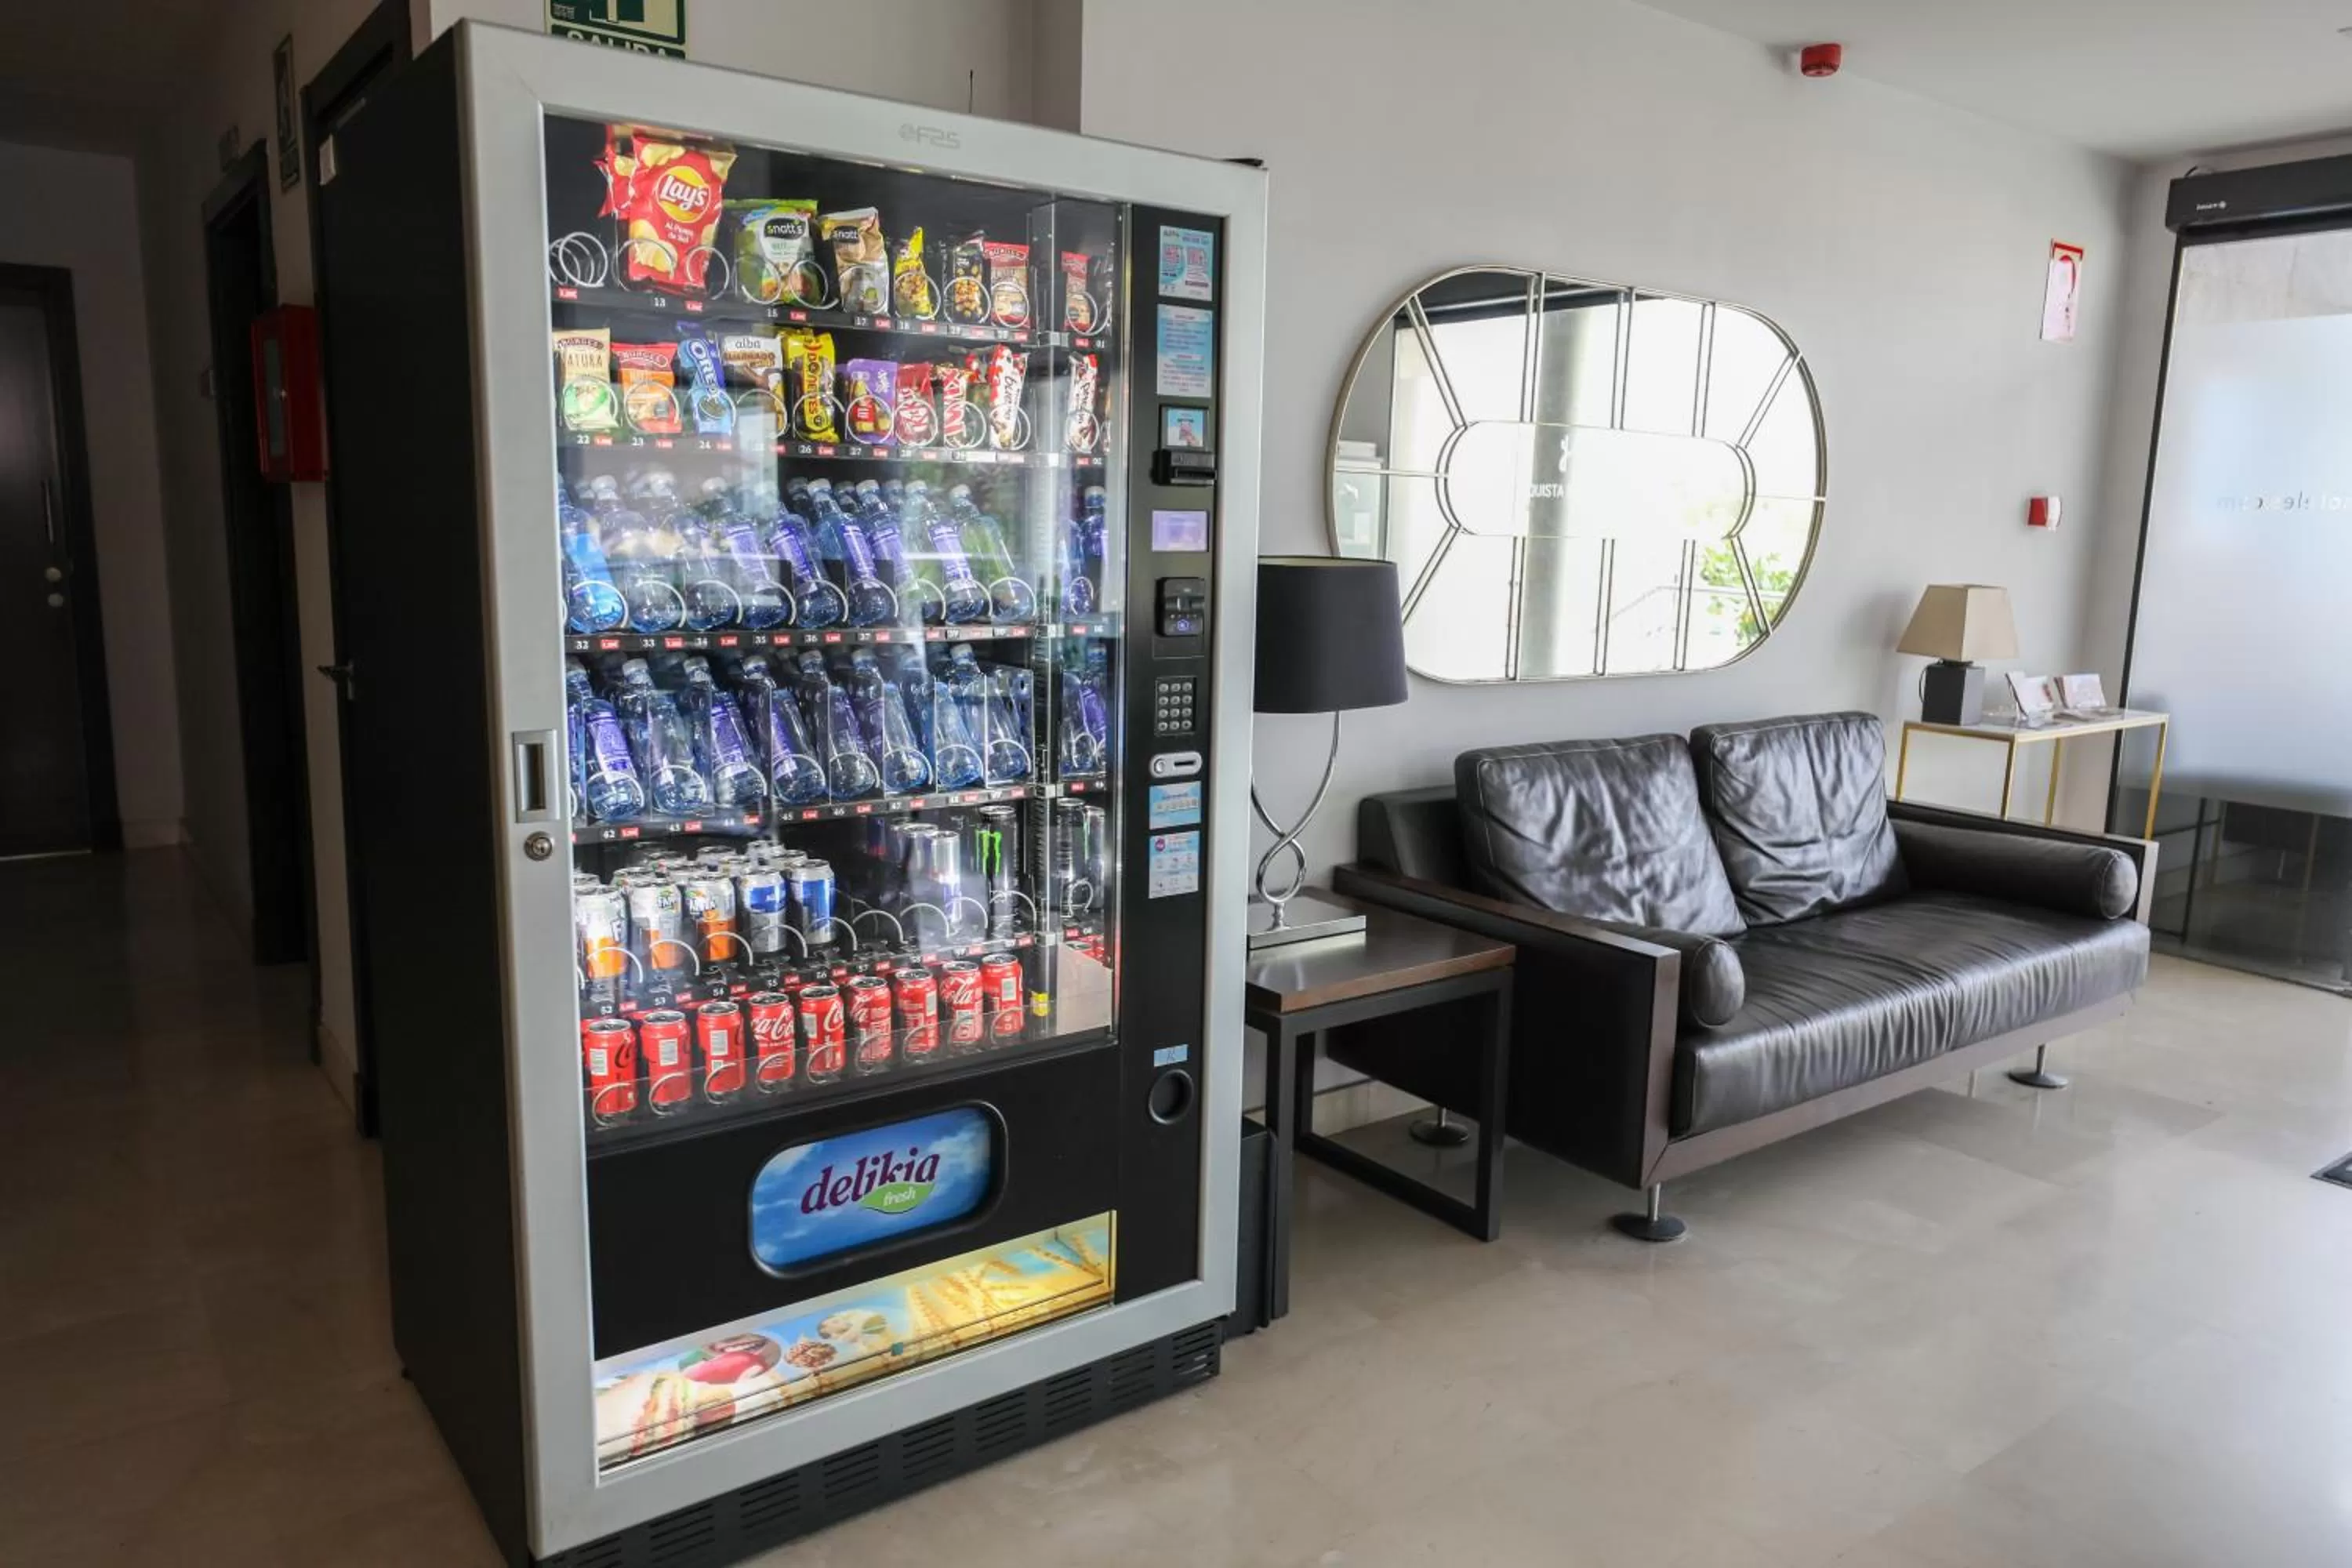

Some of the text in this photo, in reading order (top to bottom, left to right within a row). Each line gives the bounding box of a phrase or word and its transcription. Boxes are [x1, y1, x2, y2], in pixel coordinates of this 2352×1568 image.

[659, 175, 708, 210] Lay's
[800, 1146, 940, 1214] delikia
[883, 1189, 917, 1207] fresh
